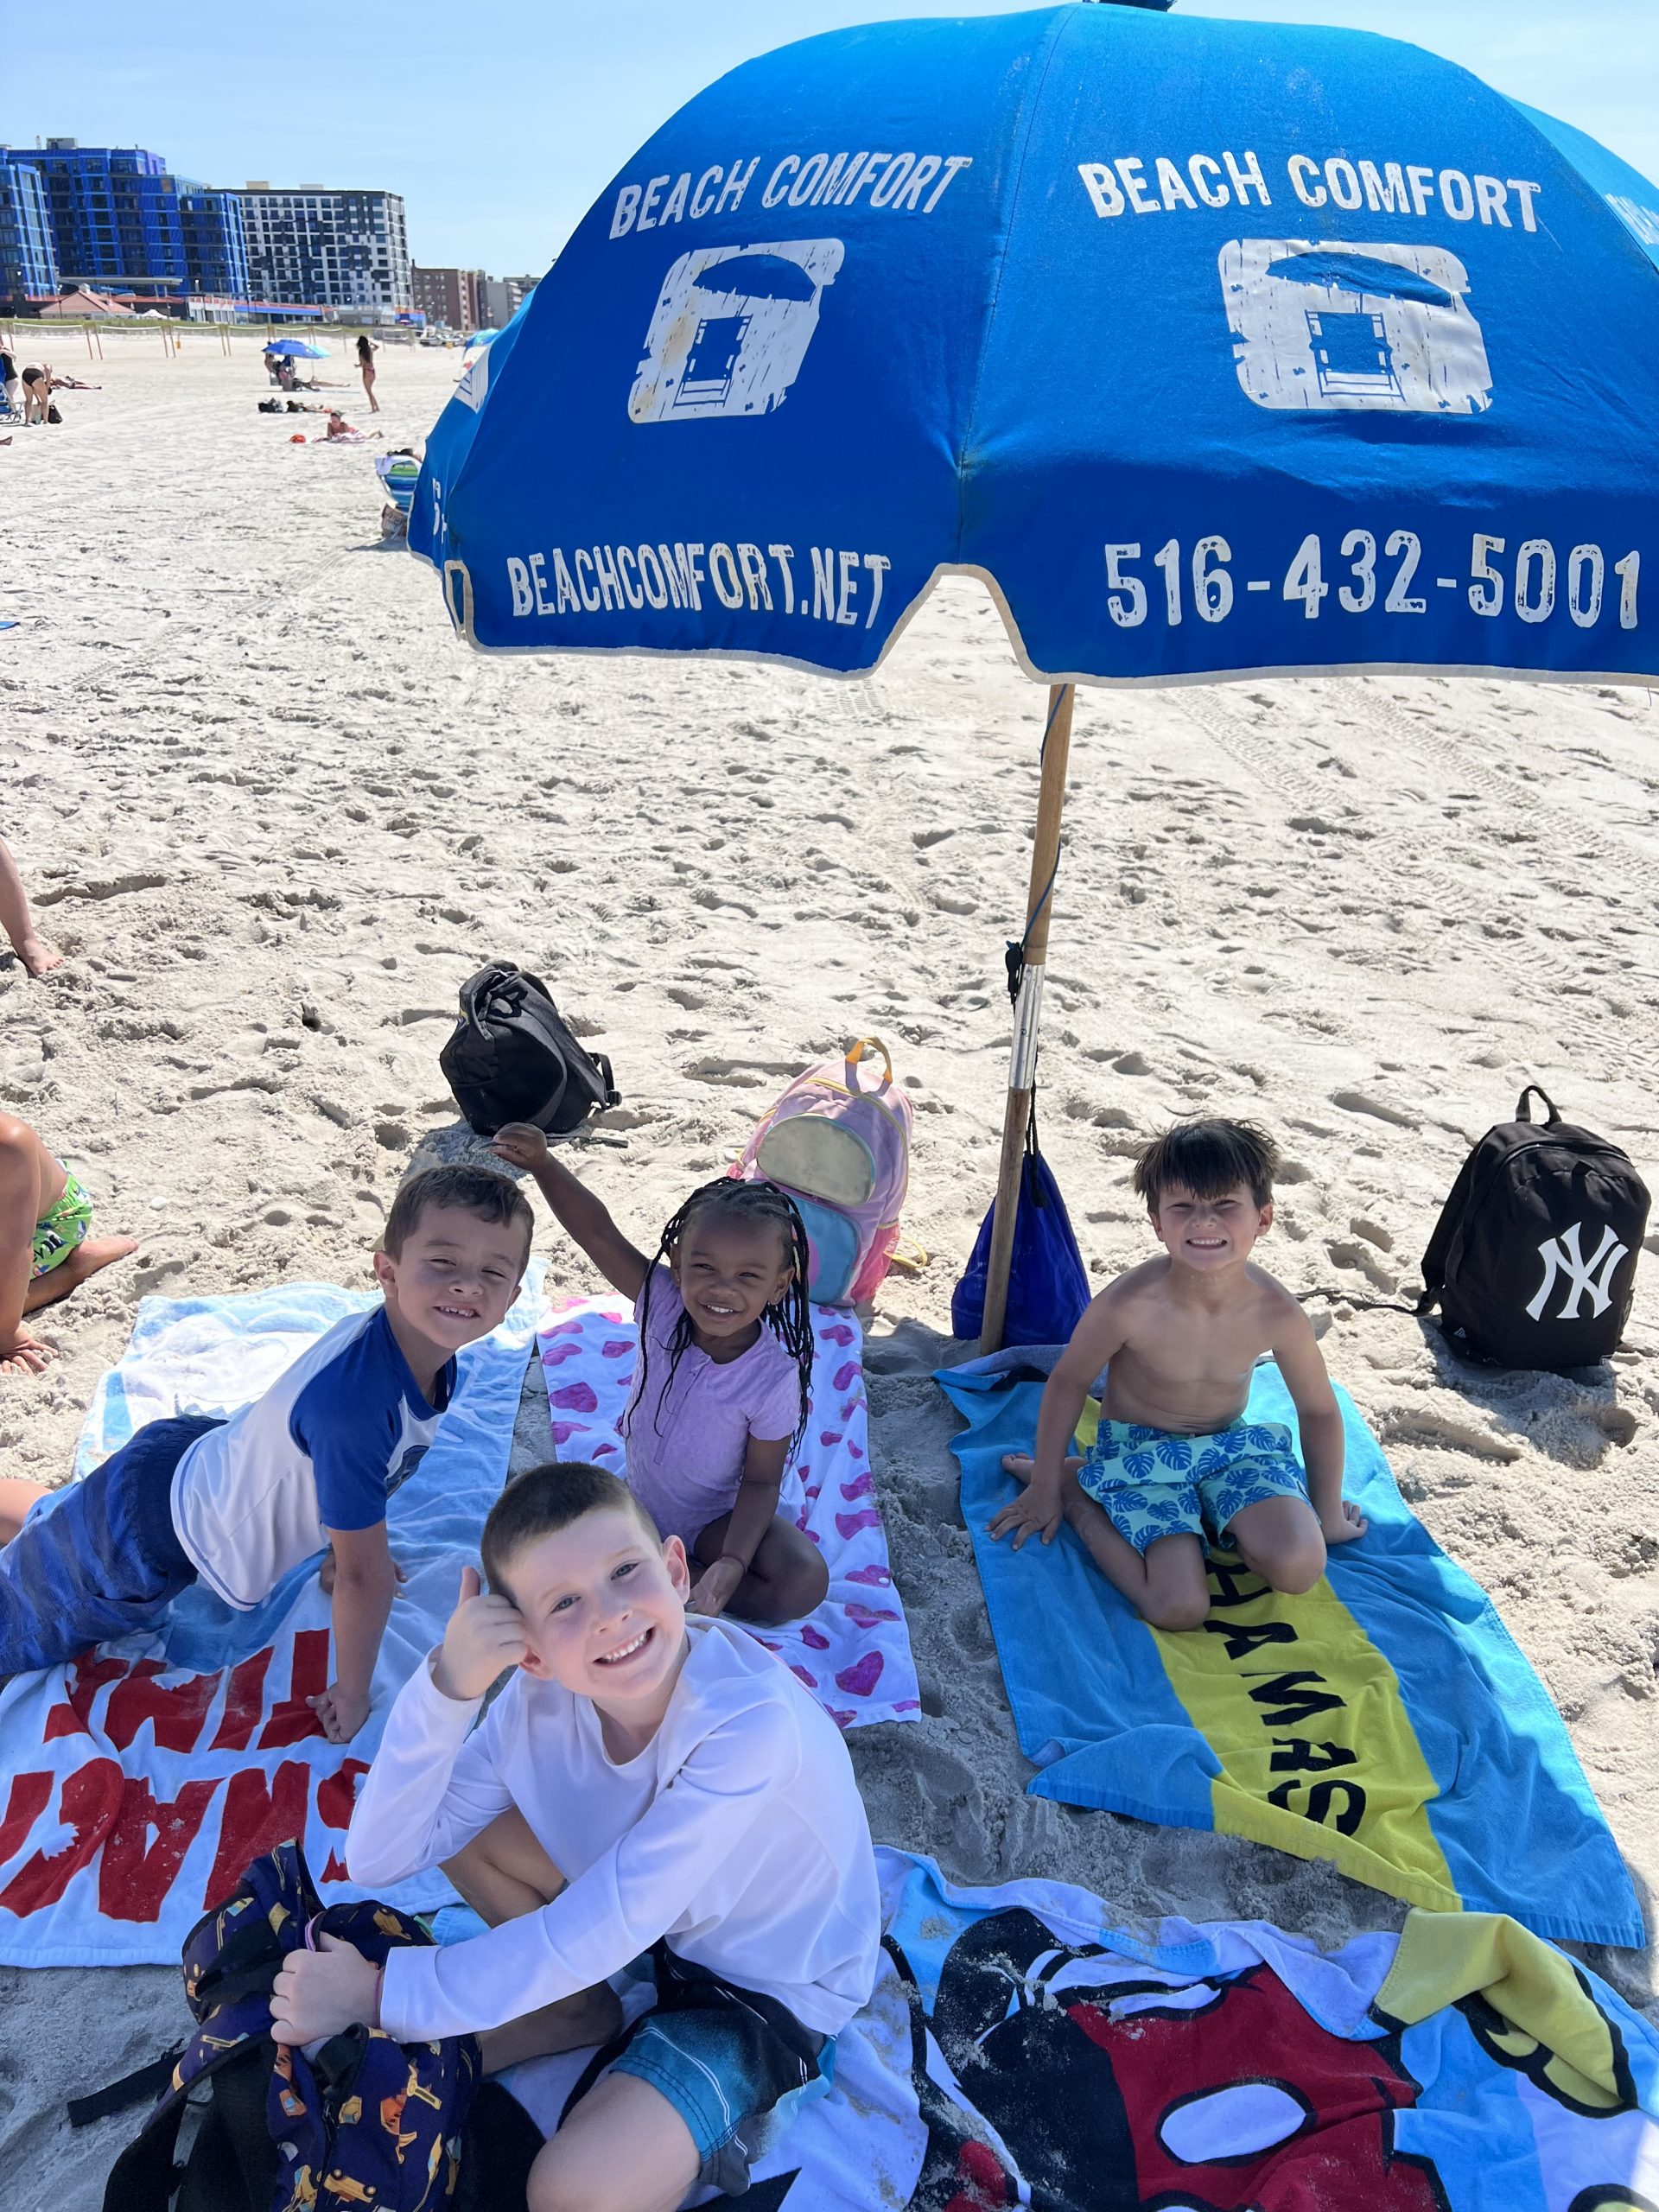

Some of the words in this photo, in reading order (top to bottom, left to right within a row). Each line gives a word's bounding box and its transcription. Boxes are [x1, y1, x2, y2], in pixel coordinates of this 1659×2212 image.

[609, 156, 761, 239] BEACH
[762, 151, 973, 213] COMFORT
[1077, 150, 1272, 219] BEACH
[1287, 154, 1541, 232] COMFORT
[506, 542, 891, 629] BEACHCOMFORT.NET
[1104, 529, 1640, 629] 516-432-5001
[1525, 1221, 1630, 1322] NY
